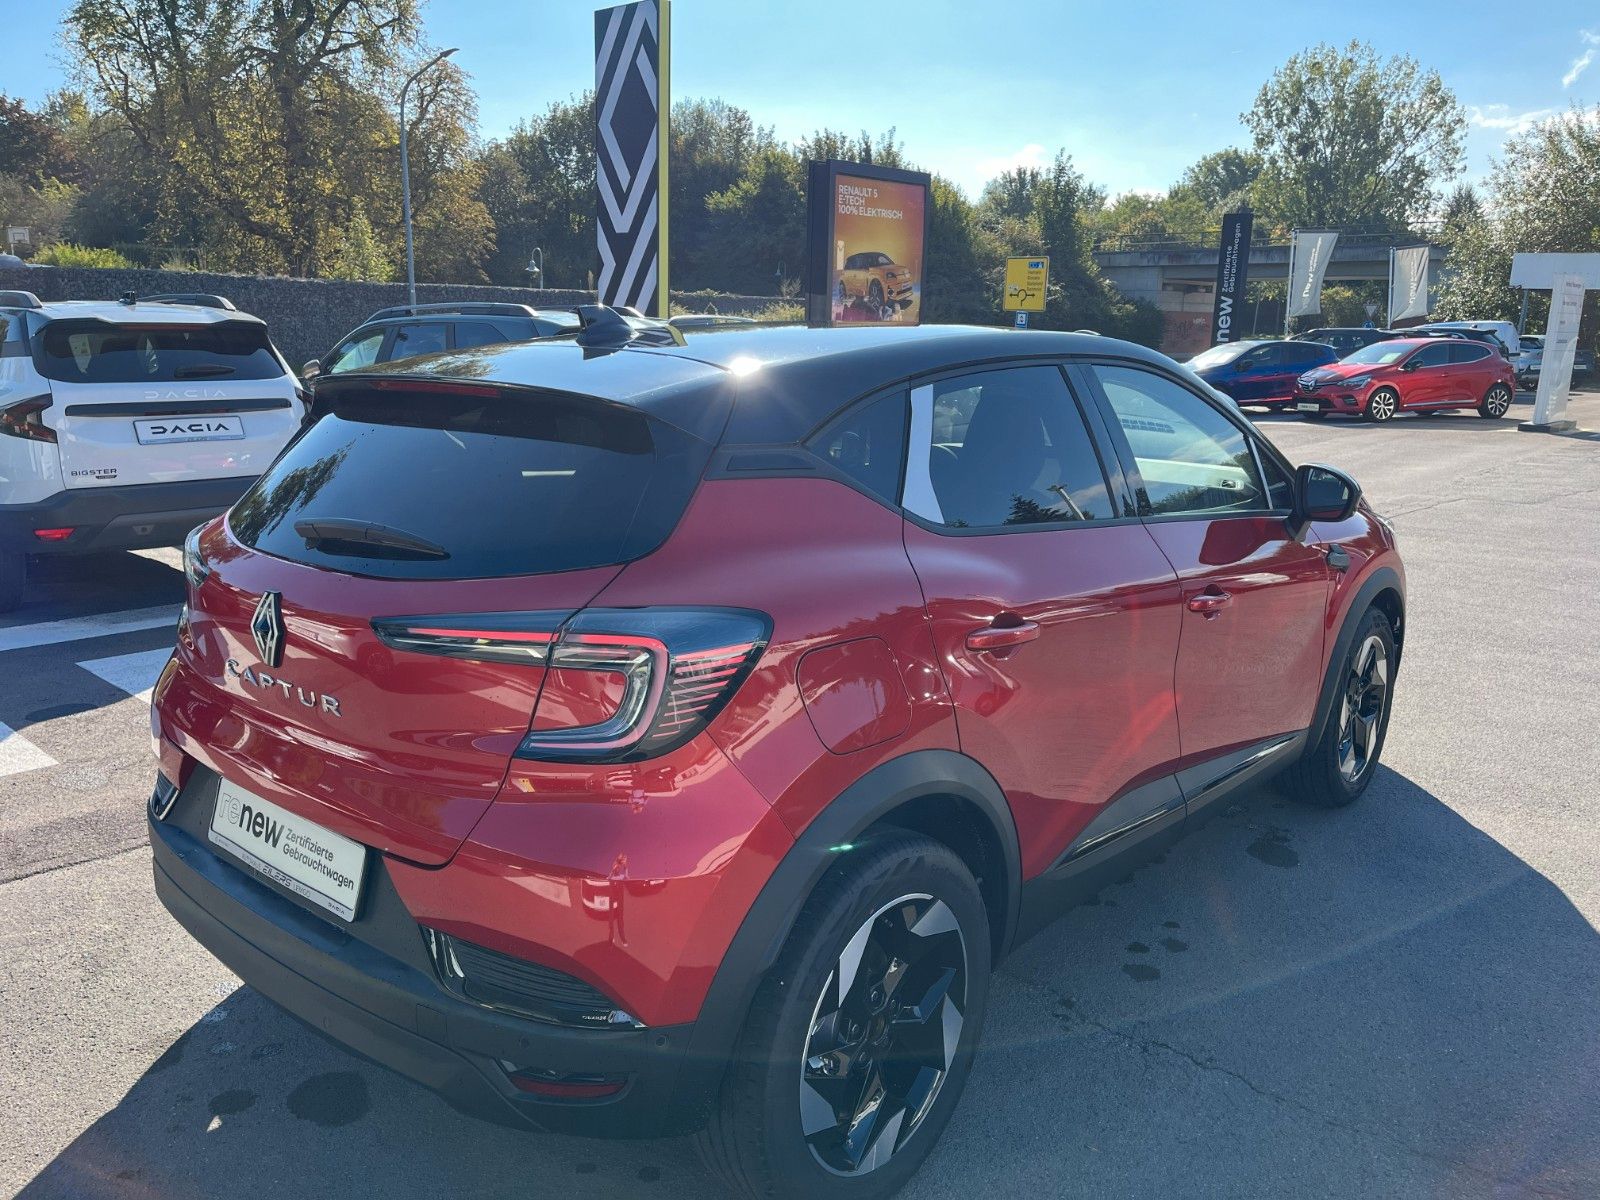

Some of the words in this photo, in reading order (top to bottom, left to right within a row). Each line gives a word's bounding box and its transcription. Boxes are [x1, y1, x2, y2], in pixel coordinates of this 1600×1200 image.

[838, 184, 872, 198] RENAULT
[873, 189, 878, 198] 5
[838, 195, 865, 206] E-TECH
[838, 205, 858, 216] 100%
[859, 207, 903, 220] ELEKTRISCH
[1229, 222, 1241, 293] Gebrauchtwagen
[1222, 246, 1233, 292] Zertifizierte
[144, 389, 227, 399] DACIA
[150, 423, 230, 435] DACIA
[71, 468, 117, 476] BIGSTER
[224, 658, 343, 718] CAPTUR
[285, 828, 335, 862] Zertifizierte
[262, 865, 293, 888] EILERS
[283, 843, 355, 891] Gebrauchtwagen
